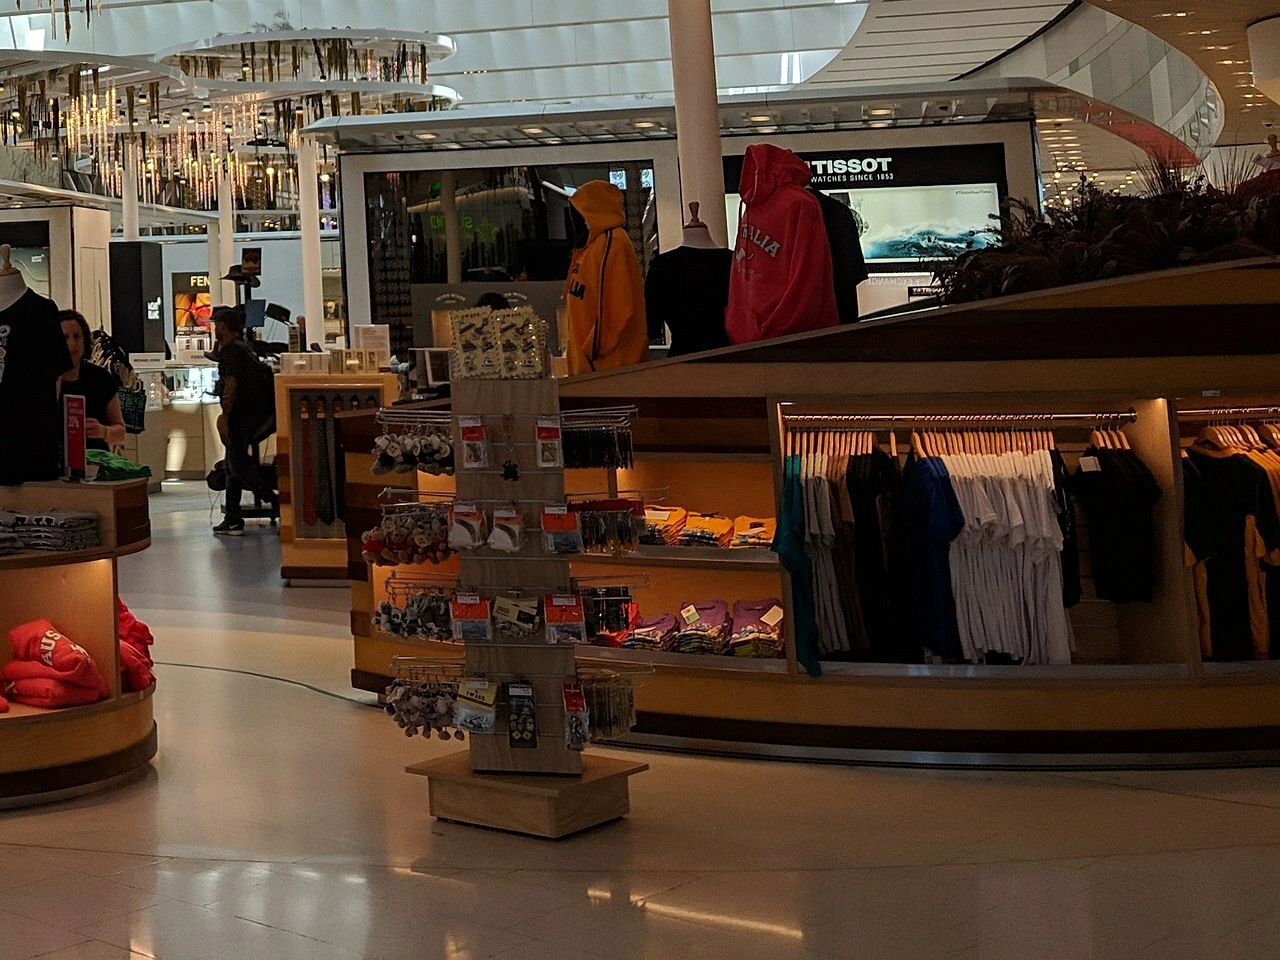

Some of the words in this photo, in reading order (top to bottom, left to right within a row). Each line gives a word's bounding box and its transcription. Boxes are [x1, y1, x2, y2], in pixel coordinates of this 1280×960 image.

[811, 157, 892, 174] TISSOT
[810, 174, 847, 183] WATCHES
[849, 173, 874, 182] SINCE
